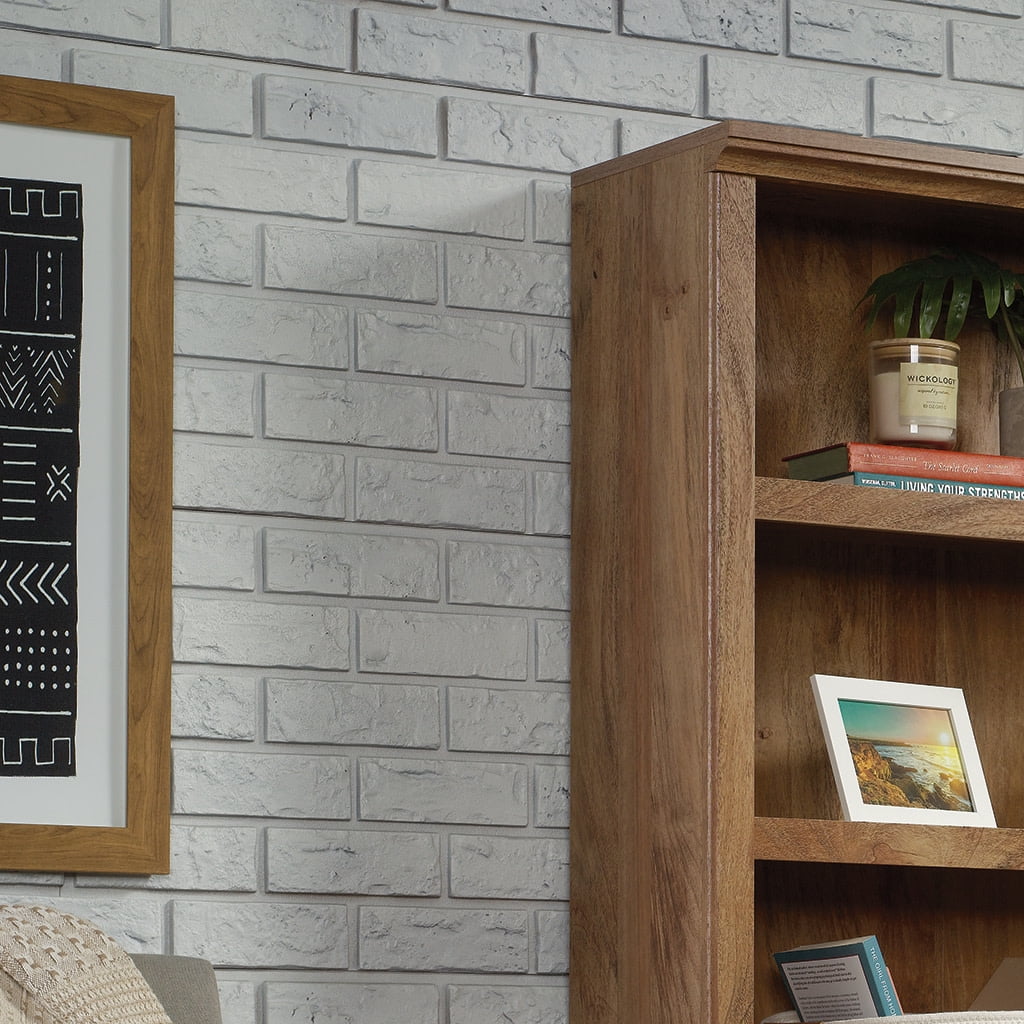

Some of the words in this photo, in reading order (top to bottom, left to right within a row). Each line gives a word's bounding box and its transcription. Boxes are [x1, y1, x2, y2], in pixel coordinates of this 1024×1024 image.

[900, 480, 934, 494] LIVING
[938, 483, 965, 496] YOUR
[869, 946, 879, 961] THE
[874, 962, 885, 980] GIRL
[881, 979, 892, 1004] FROM
